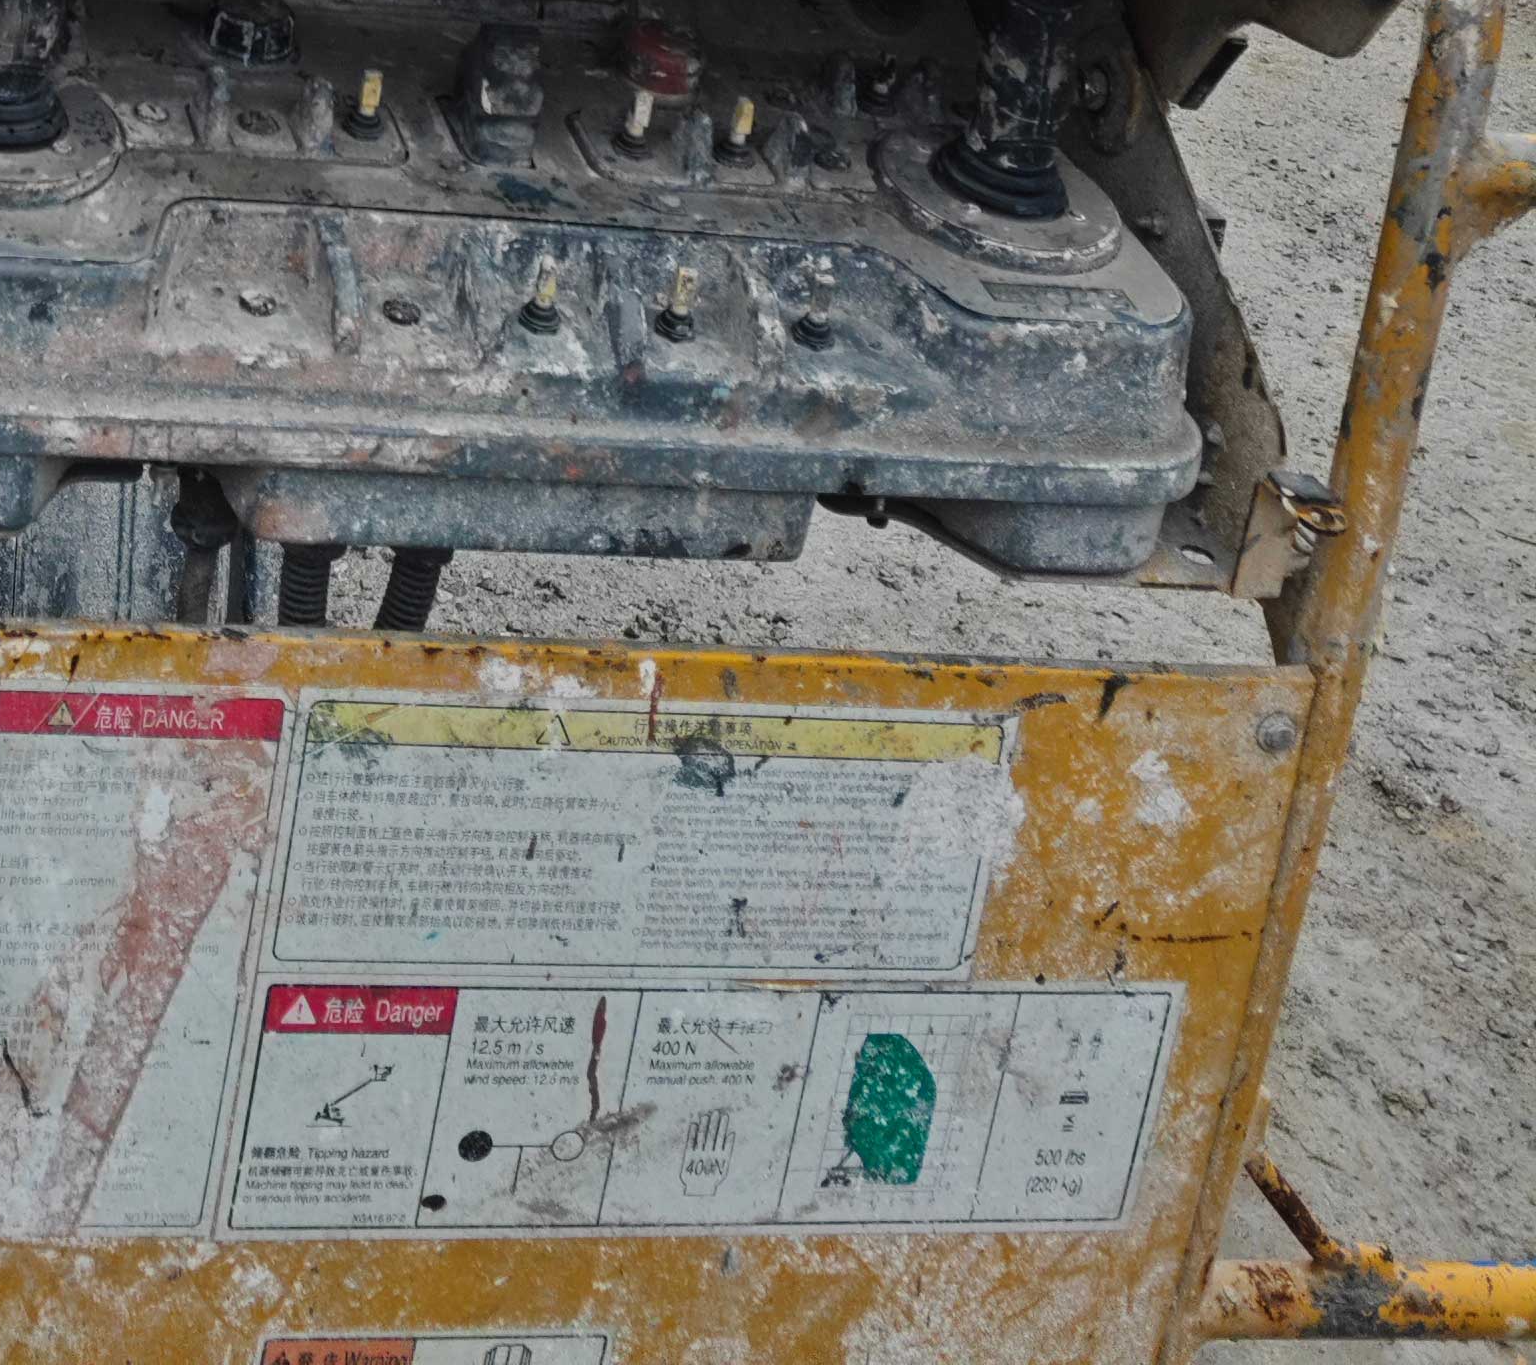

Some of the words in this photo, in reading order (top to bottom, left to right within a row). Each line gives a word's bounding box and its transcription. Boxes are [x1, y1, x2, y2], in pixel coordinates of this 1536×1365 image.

[94, 705, 133, 730] 危险
[142, 707, 224, 730] DANGER
[600, 735, 642, 746] CAUTION
[725, 739, 782, 750] OPERATION
[323, 997, 365, 1024] 危险
[376, 999, 445, 1027] Danger
[474, 1015, 575, 1034] 最大允许风速
[472, 1038, 504, 1055] 12.5
[652, 1040, 680, 1056] 400
[685, 1040, 696, 1056] N
[466, 1058, 520, 1070] Maximum
[522, 1058, 575, 1070] allowable
[649, 1058, 701, 1070] Maximum
[704, 1058, 756, 1070] allowable
[464, 1074, 489, 1085] wind
[308, 1147, 348, 1162] Tipping
[351, 1147, 390, 1159] hazard
[1034, 1149, 1062, 1166] 500
[1064, 1150, 1086, 1166] lbs
[245, 1180, 287, 1190] Machine
